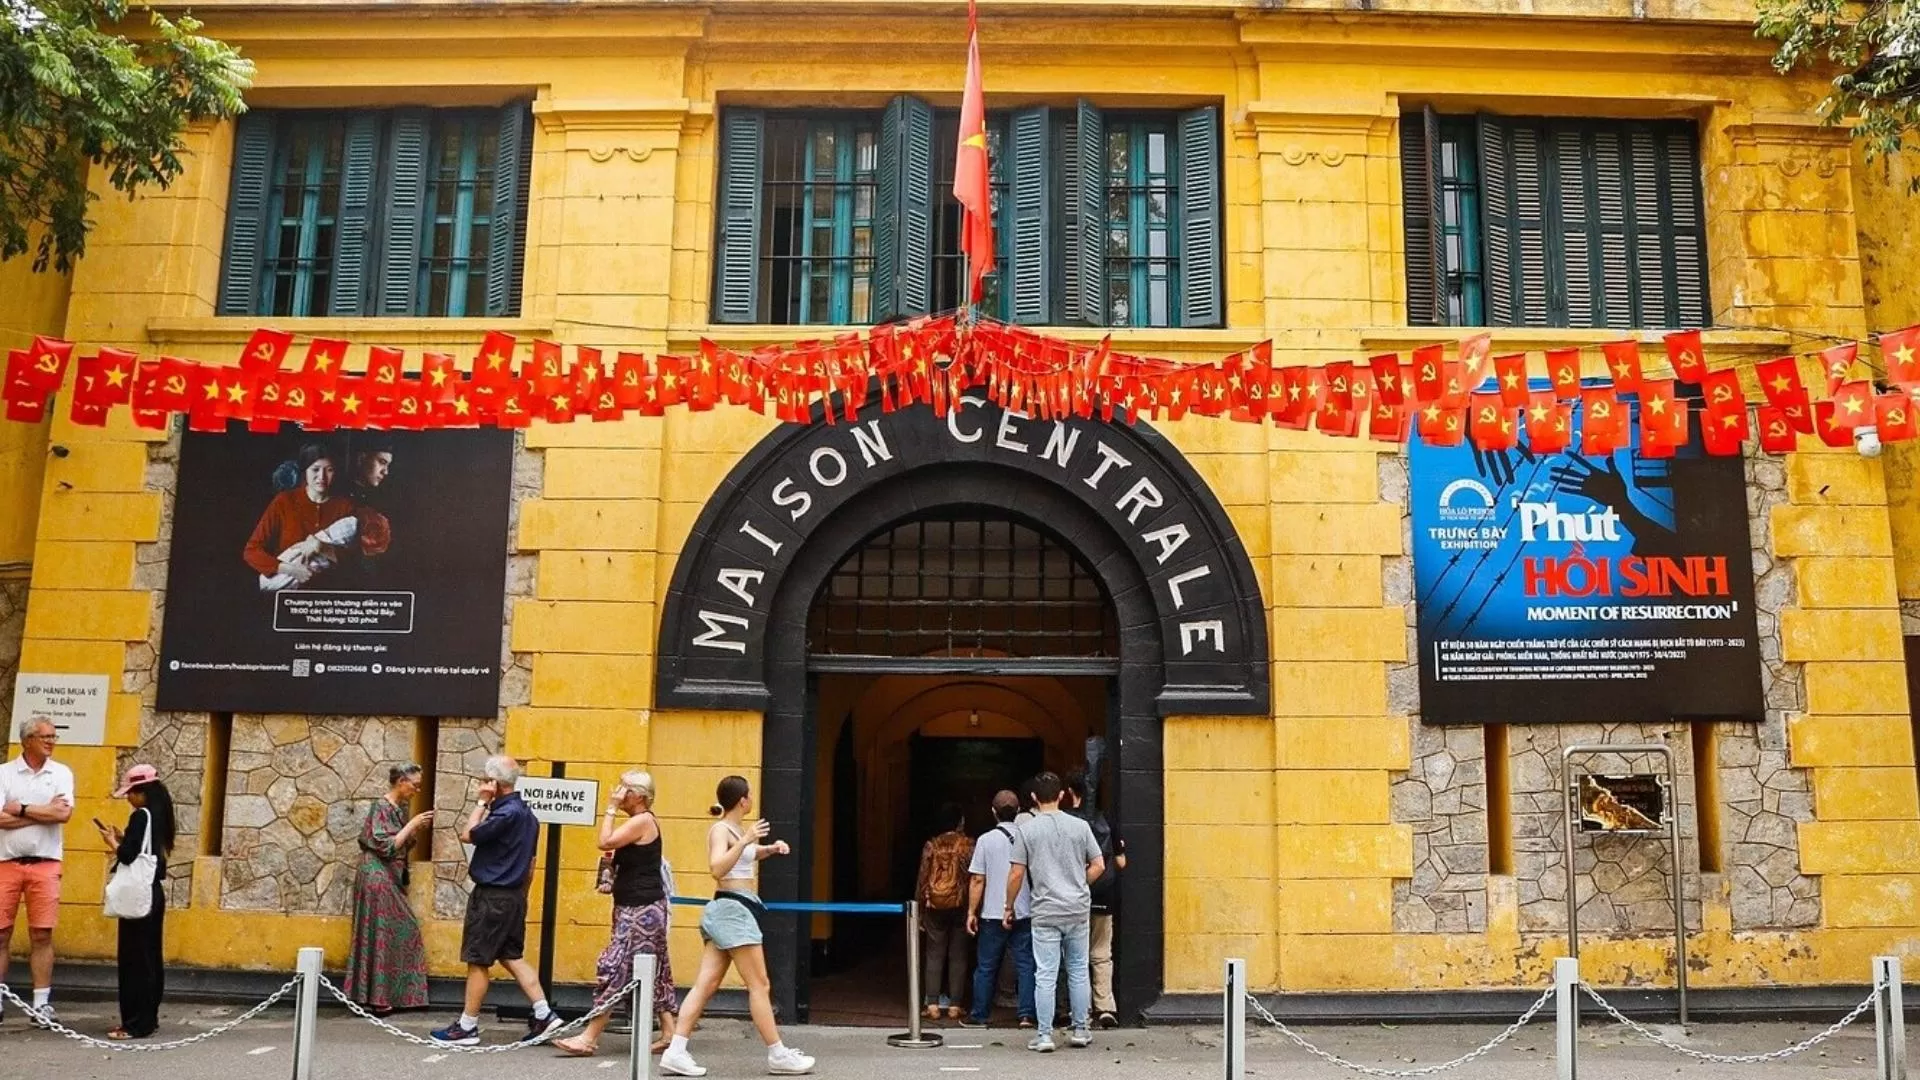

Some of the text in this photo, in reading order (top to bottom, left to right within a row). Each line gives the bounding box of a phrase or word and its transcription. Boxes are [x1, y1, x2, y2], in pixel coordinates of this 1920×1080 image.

[692, 396, 1224, 656] MAISON CENTRALE
[1428, 525, 1508, 539] TRƯNG BÀY
[1440, 540, 1498, 549] EXHIBITION
[1523, 541, 1730, 597] HỒI SINH
[1527, 606, 1598, 621] MOMENT
[1600, 606, 1619, 620] OF
[360, 616, 379, 624] phút
[385, 665, 406, 674] Đăng
[43, 686, 66, 695] HÀNG
[67, 687, 86, 696] MUA
[523, 788, 586, 801] NƠI BÁN VÉ
[555, 802, 584, 813] Office
